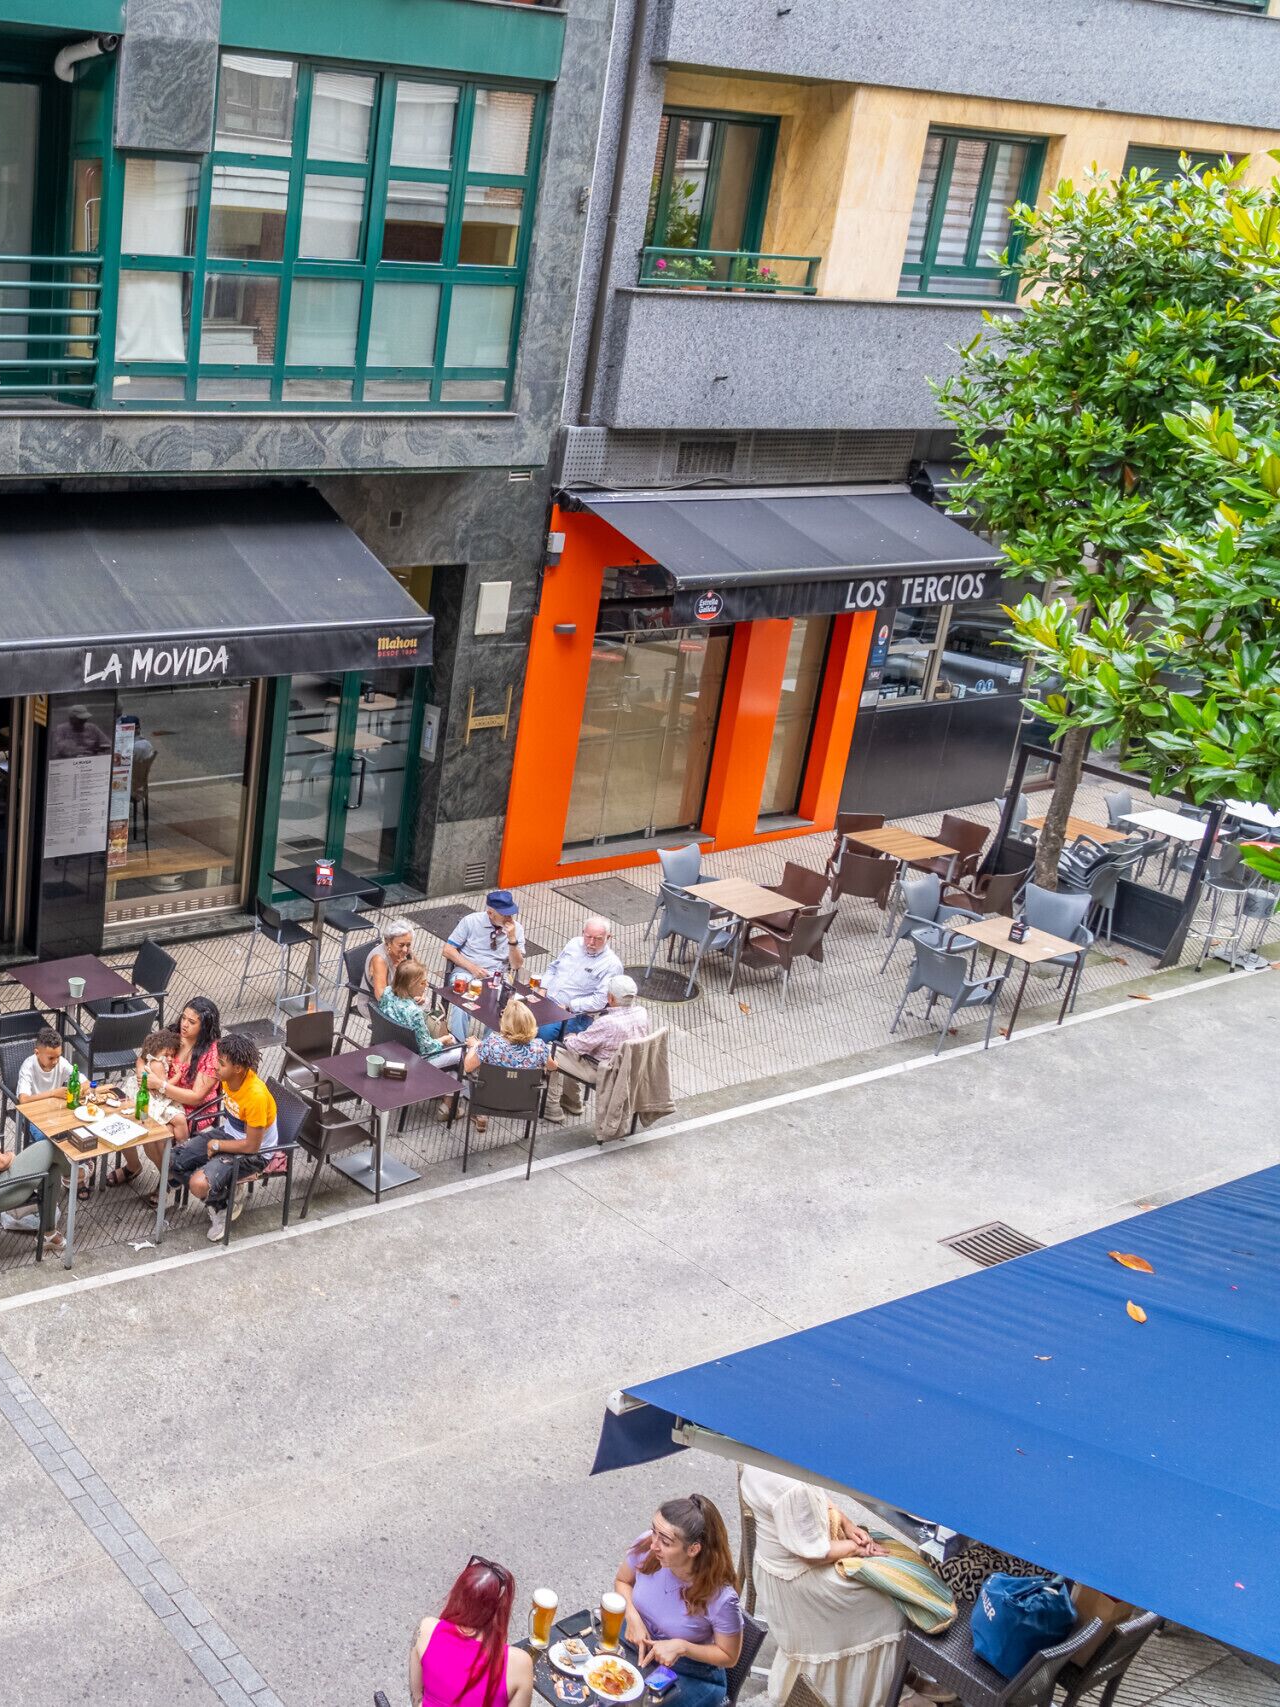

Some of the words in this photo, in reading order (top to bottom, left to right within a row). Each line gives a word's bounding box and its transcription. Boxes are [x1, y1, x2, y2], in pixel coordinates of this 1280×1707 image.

[845, 579, 887, 609] LOS
[901, 572, 986, 605] TERCIOS
[377, 635, 418, 650] Mahou
[377, 649, 398, 657] DESDE
[83, 652, 123, 684] LA
[130, 645, 230, 682] MOVIDA
